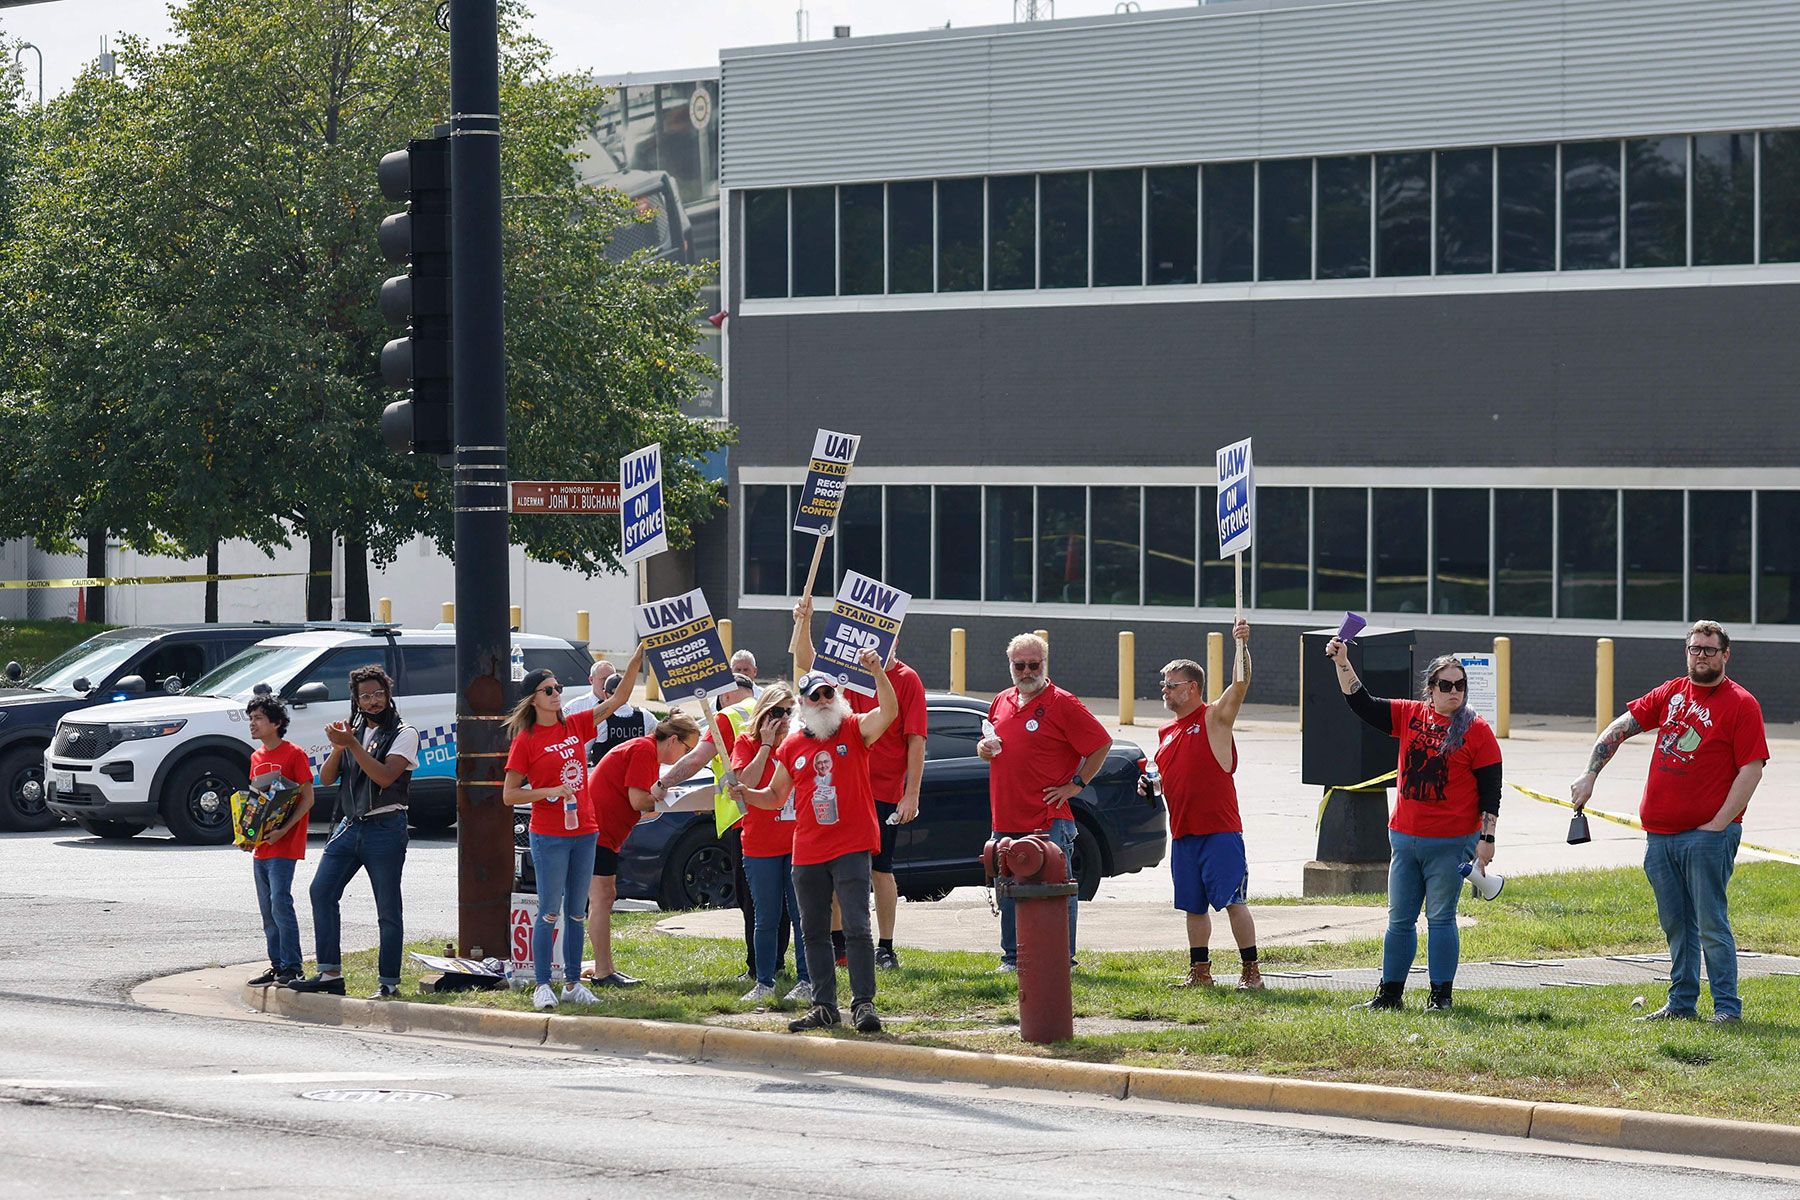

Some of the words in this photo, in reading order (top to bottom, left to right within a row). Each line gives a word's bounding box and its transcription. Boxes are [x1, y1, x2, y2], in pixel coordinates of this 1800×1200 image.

[623, 450, 657, 490] UAW
[813, 462, 847, 475] STAND
[1219, 444, 1248, 482] UAW
[560, 486, 594, 494] HONORARY
[817, 478, 846, 489] RECO
[517, 496, 545, 507] ALDERMAN
[548, 494, 568, 509] JOHN
[571, 495, 579, 509] J.
[634, 493, 649, 518] ON
[811, 497, 840, 508] RECO
[1226, 486, 1237, 511] ON
[625, 508, 662, 547] STRIKE
[1221, 503, 1249, 540] STRIKE
[26, 580, 50, 588] CAUTION
[72, 579, 96, 587] CAUTION
[162, 575, 187, 584] CAUTION
[850, 577, 900, 614] UAW
[643, 596, 694, 629] UAW
[836, 605, 876, 625] STAND
[878, 620, 895, 631] UP
[646, 629, 689, 647] STAND
[691, 620, 709, 632] UP
[835, 623, 880, 650] END
[660, 638, 707, 660] RECORD
[663, 646, 711, 668] PROFITS
[661, 662, 728, 689] CONTRACTS
[667, 657, 714, 678] RECORD
[610, 726, 644, 739] POLICE
[544, 735, 580, 753] STAND
[559, 748, 576, 760] UP
